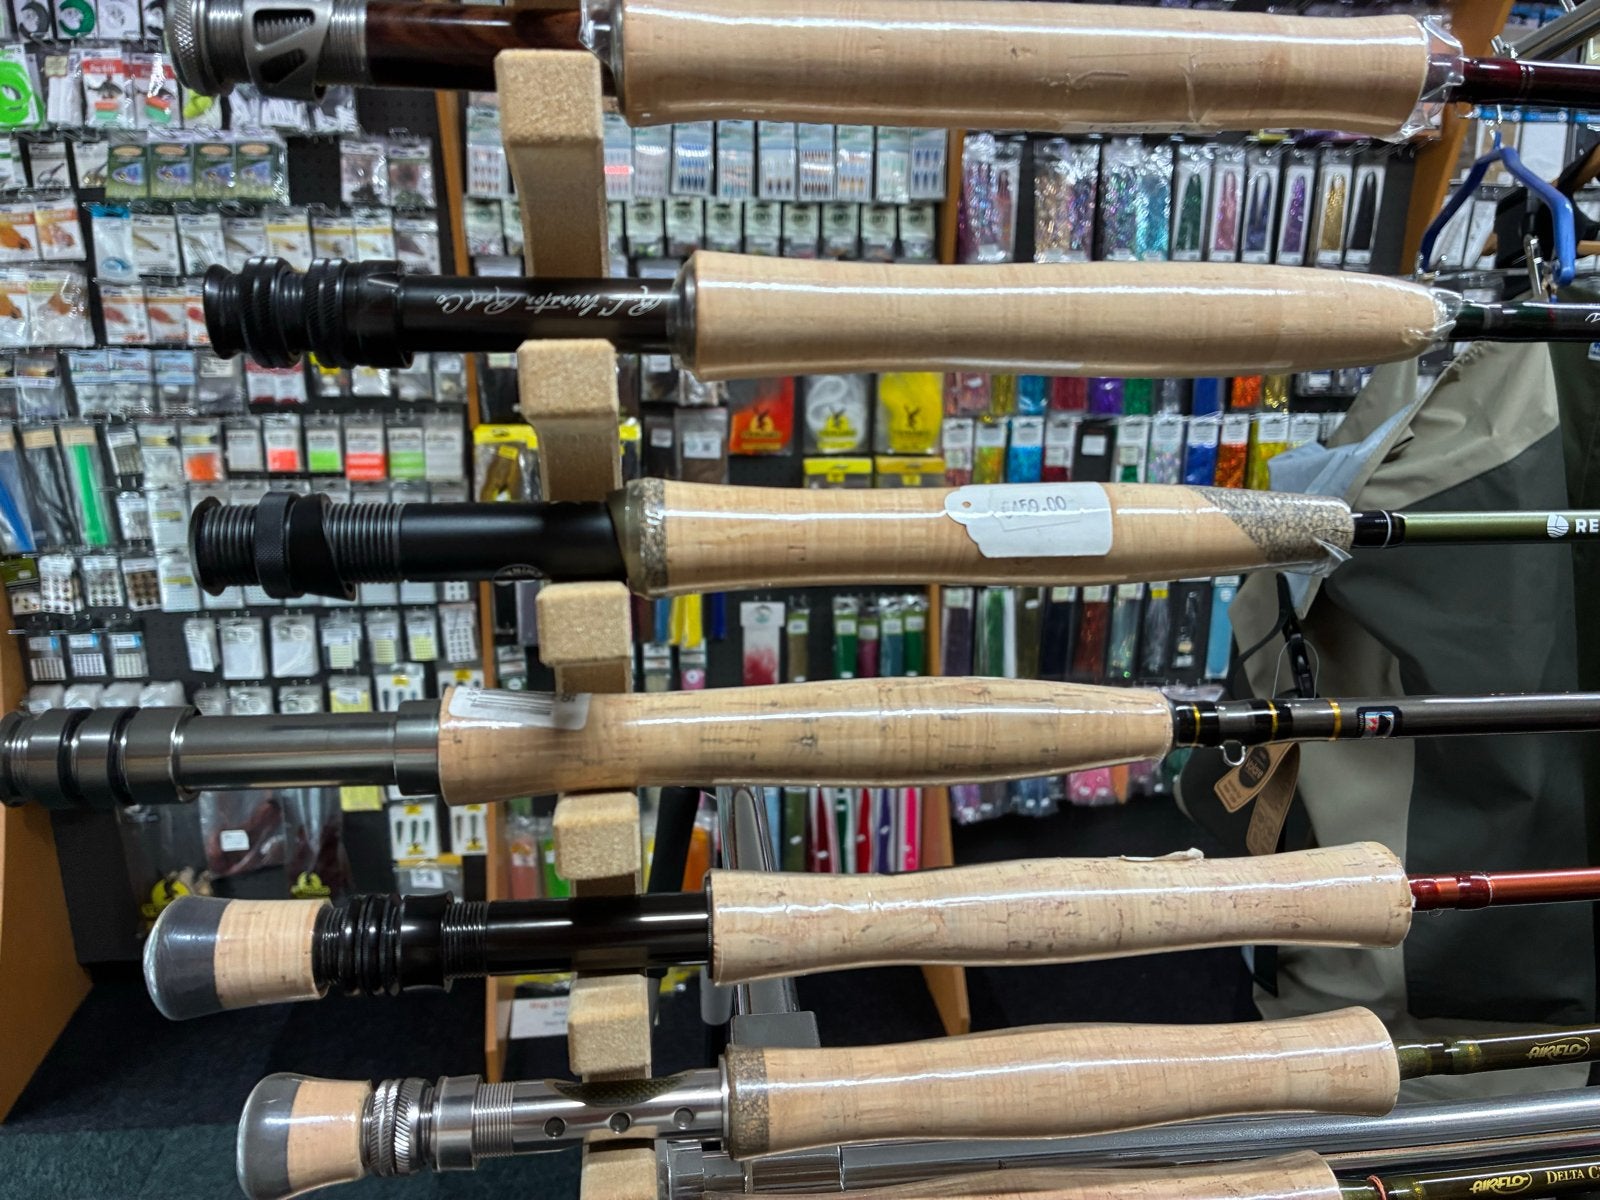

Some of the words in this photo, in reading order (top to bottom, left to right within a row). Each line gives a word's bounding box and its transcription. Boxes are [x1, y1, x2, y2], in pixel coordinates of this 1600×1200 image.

[466, 286, 522, 315] Rod
[525, 291, 600, 316] Winston
[1575, 518, 1599, 533] RE
[1526, 1041, 1588, 1060] AIRFLO
[1469, 1174, 1530, 1194] AIRFLO
